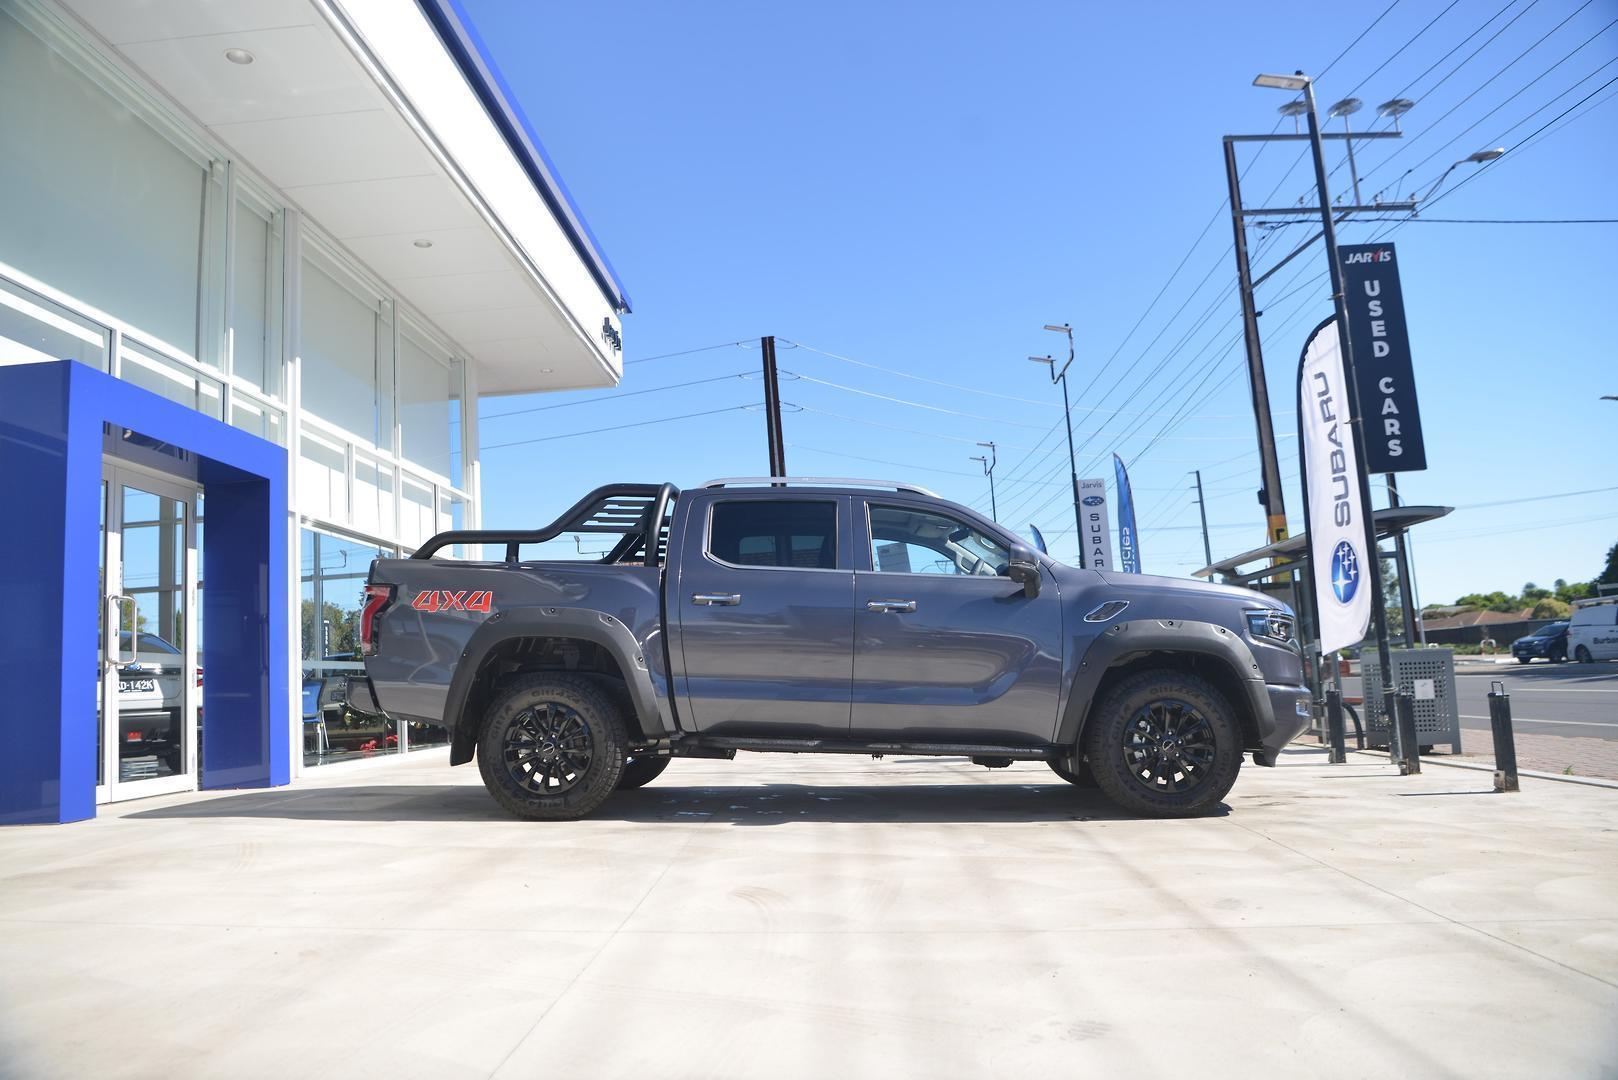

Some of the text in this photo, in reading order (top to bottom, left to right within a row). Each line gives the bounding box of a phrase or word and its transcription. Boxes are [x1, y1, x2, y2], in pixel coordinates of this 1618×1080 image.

[1344, 249, 1392, 264] JARVIS
[1363, 279, 1403, 457] USED CARS
[1313, 371, 1351, 528] SUBARU
[1081, 481, 1103, 489] Jarvis
[411, 590, 493, 614] 4X4
